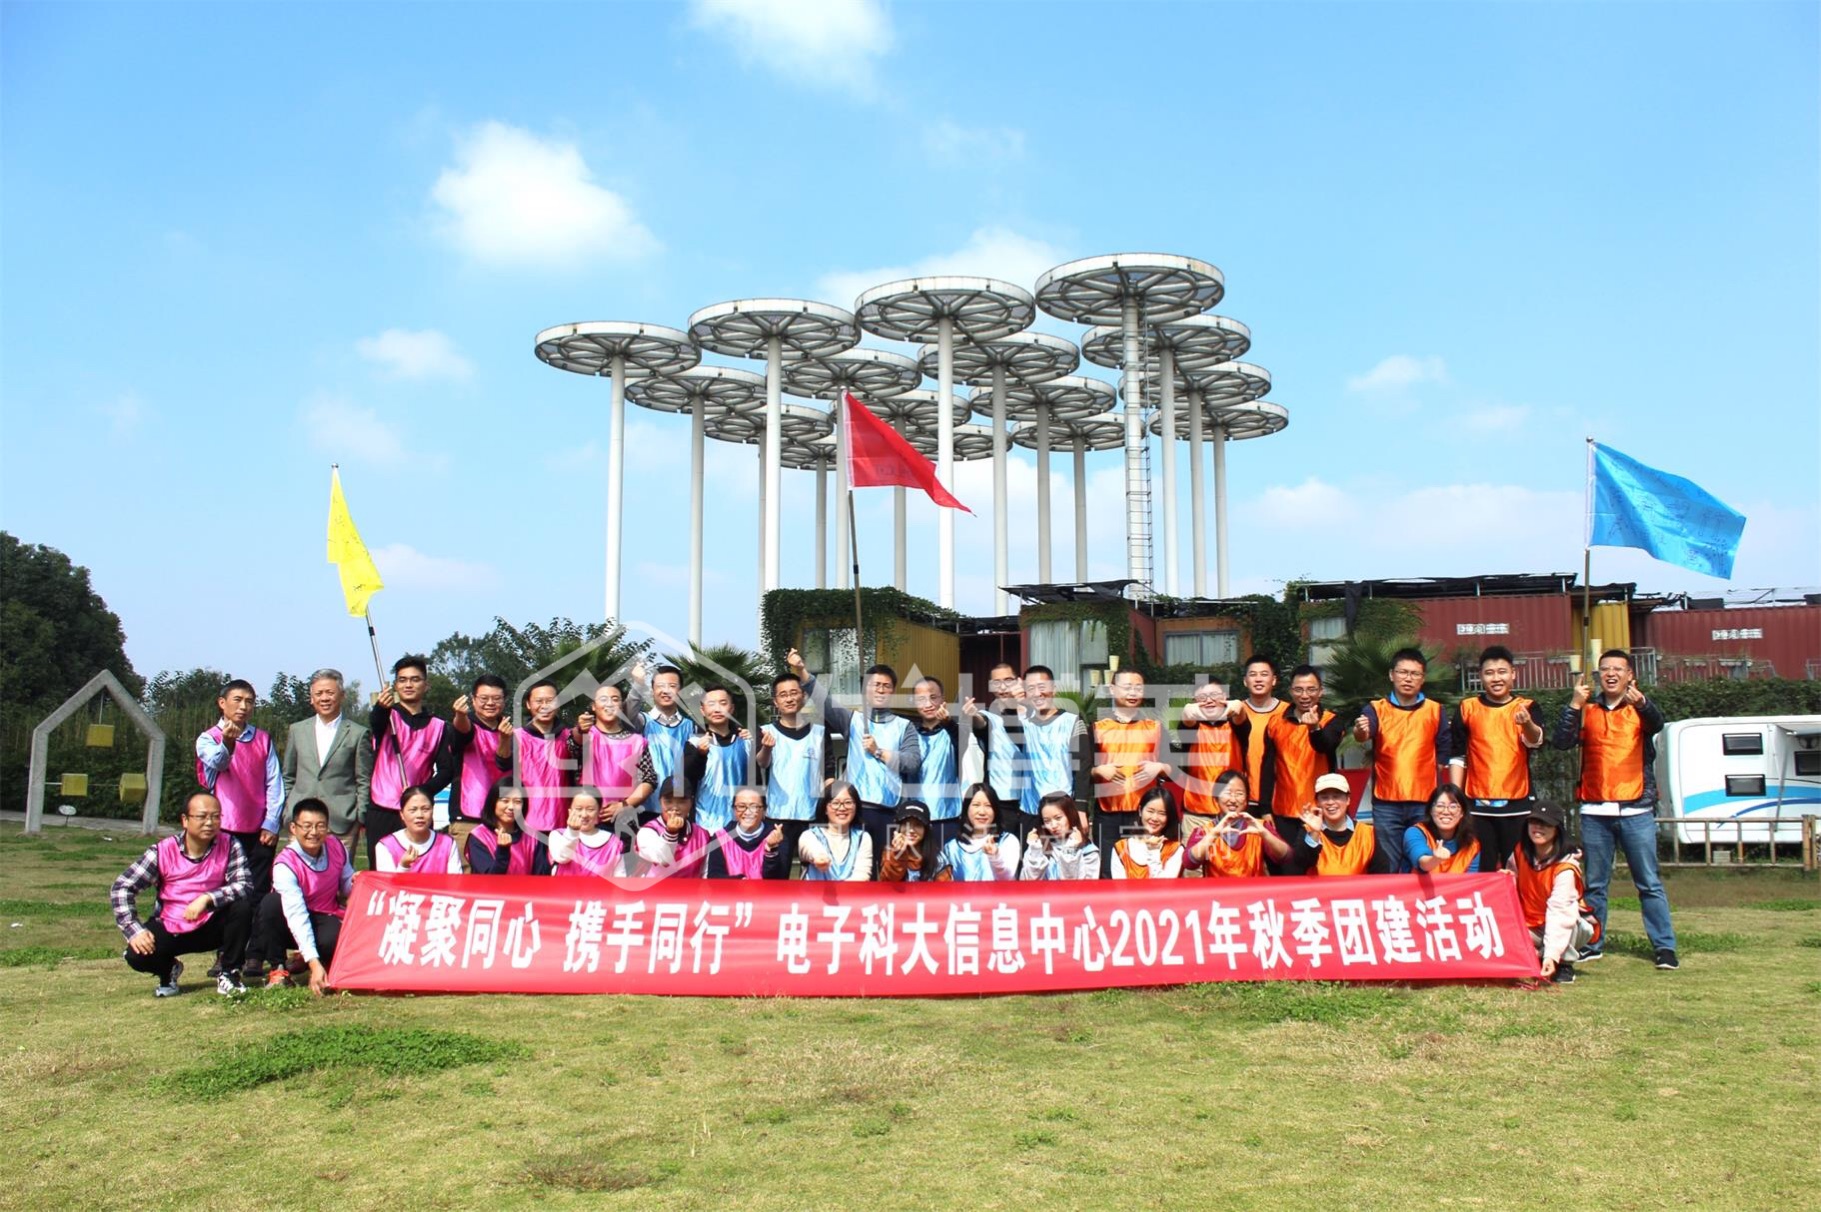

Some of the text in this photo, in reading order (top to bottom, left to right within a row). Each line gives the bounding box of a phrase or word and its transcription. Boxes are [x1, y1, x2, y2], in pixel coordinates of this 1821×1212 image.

[366, 890, 1505, 976] “凝聚同心 携手同行” 电子科大信息中心2021年秋季团建活动
